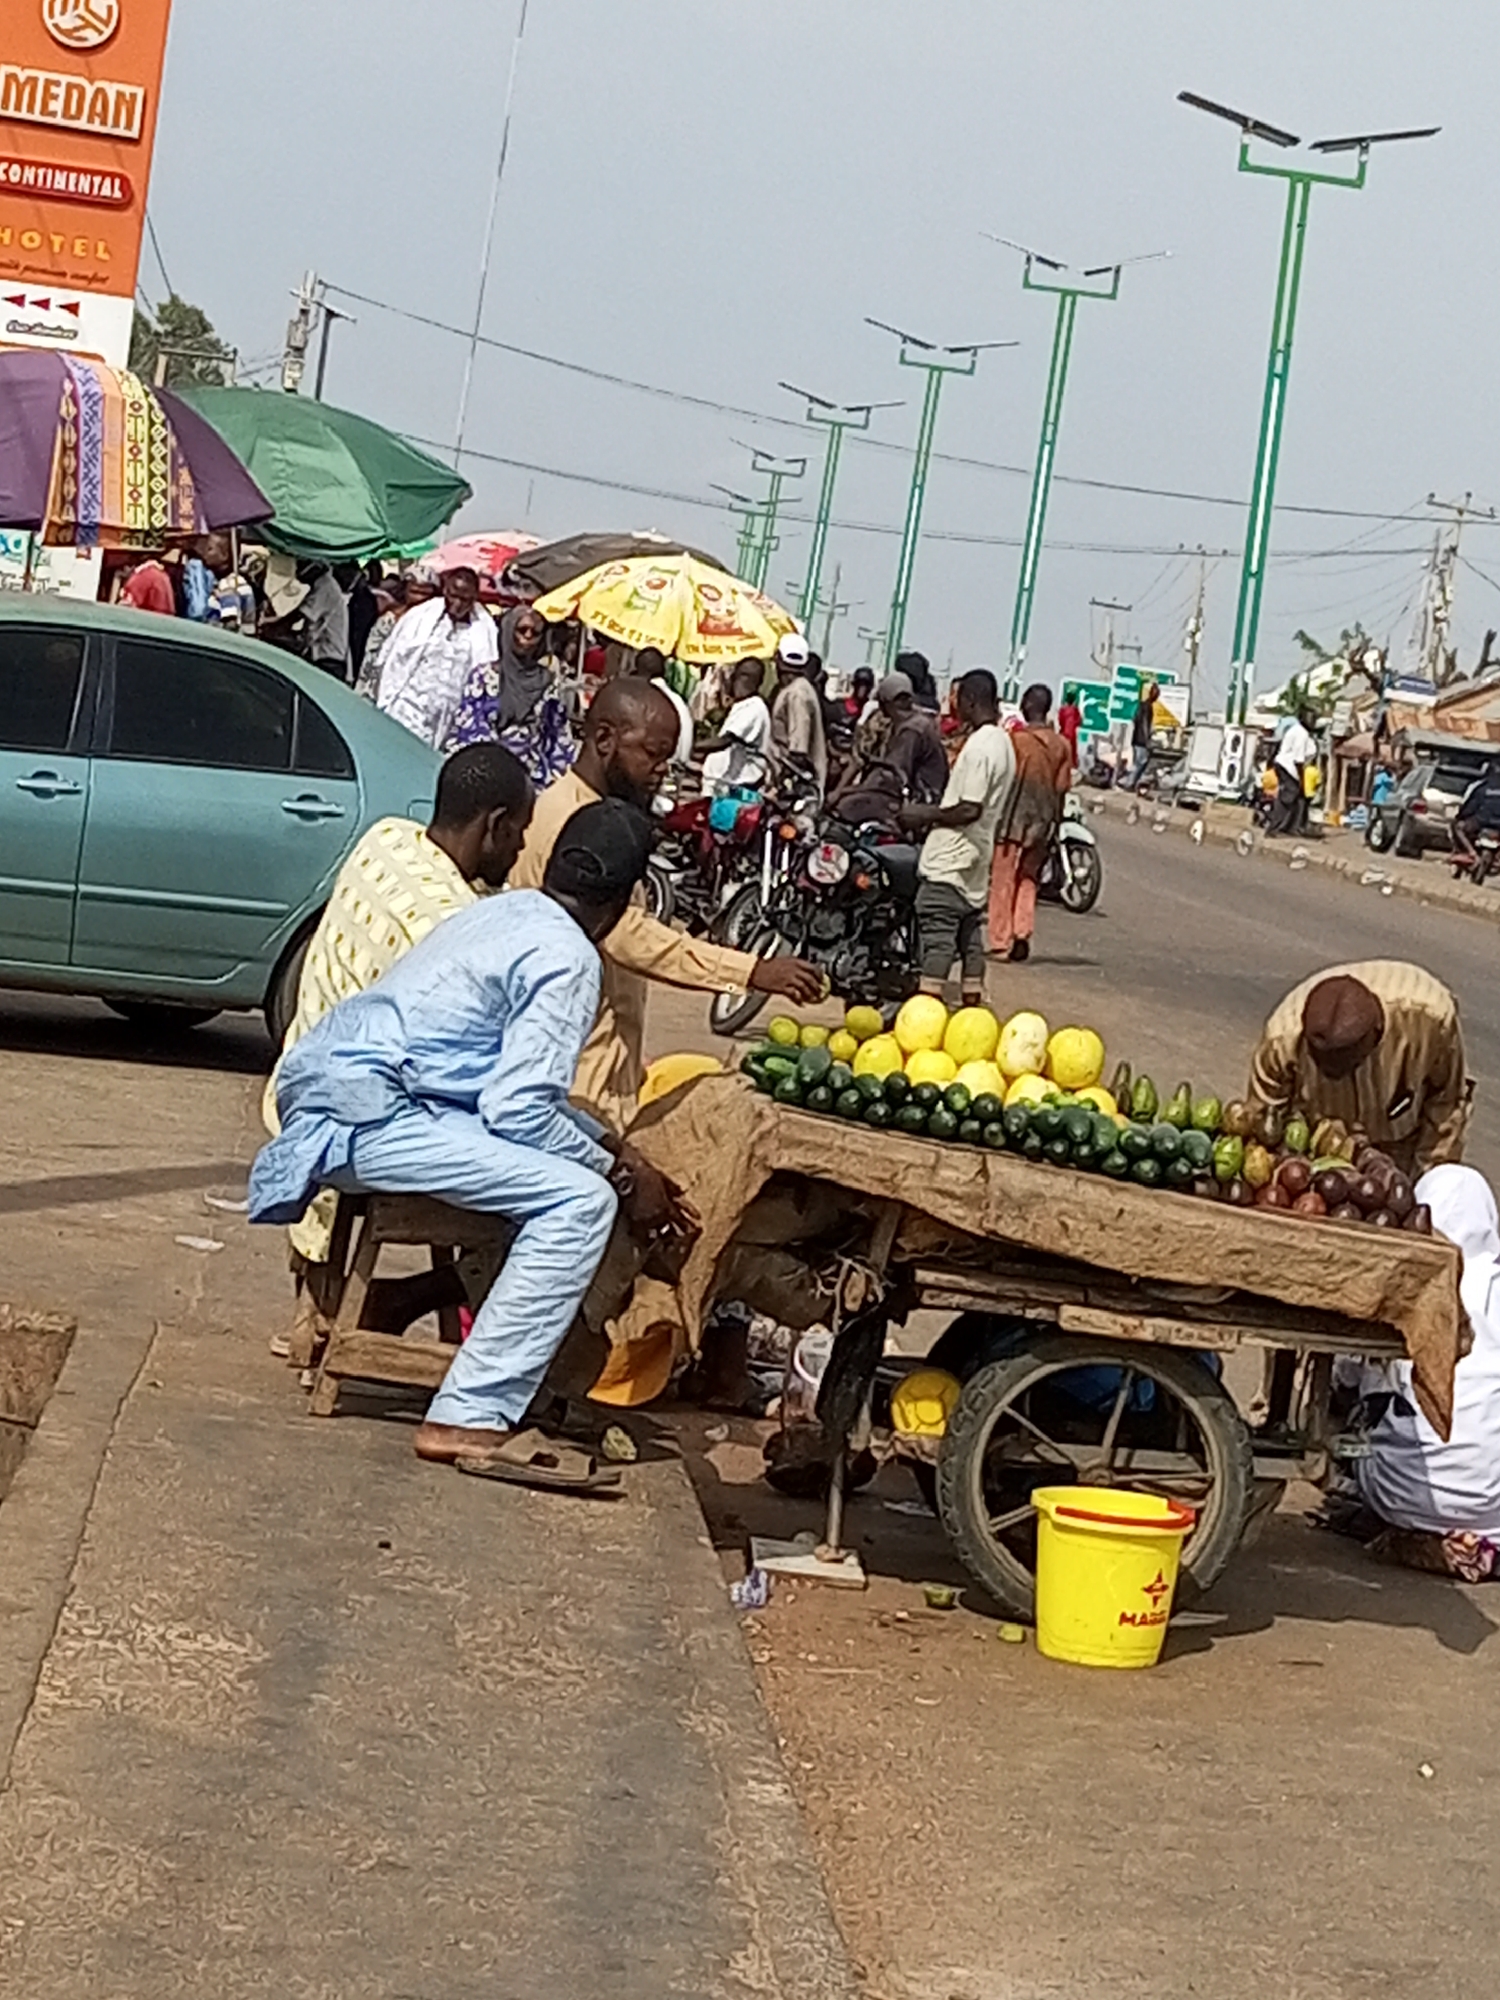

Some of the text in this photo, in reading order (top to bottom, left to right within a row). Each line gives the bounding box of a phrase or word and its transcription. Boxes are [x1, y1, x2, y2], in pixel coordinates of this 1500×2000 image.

[1, 72, 138, 131] MEDAN
[0, 162, 123, 199] CONTINENTAL
[0, 226, 111, 261] HOTEL
